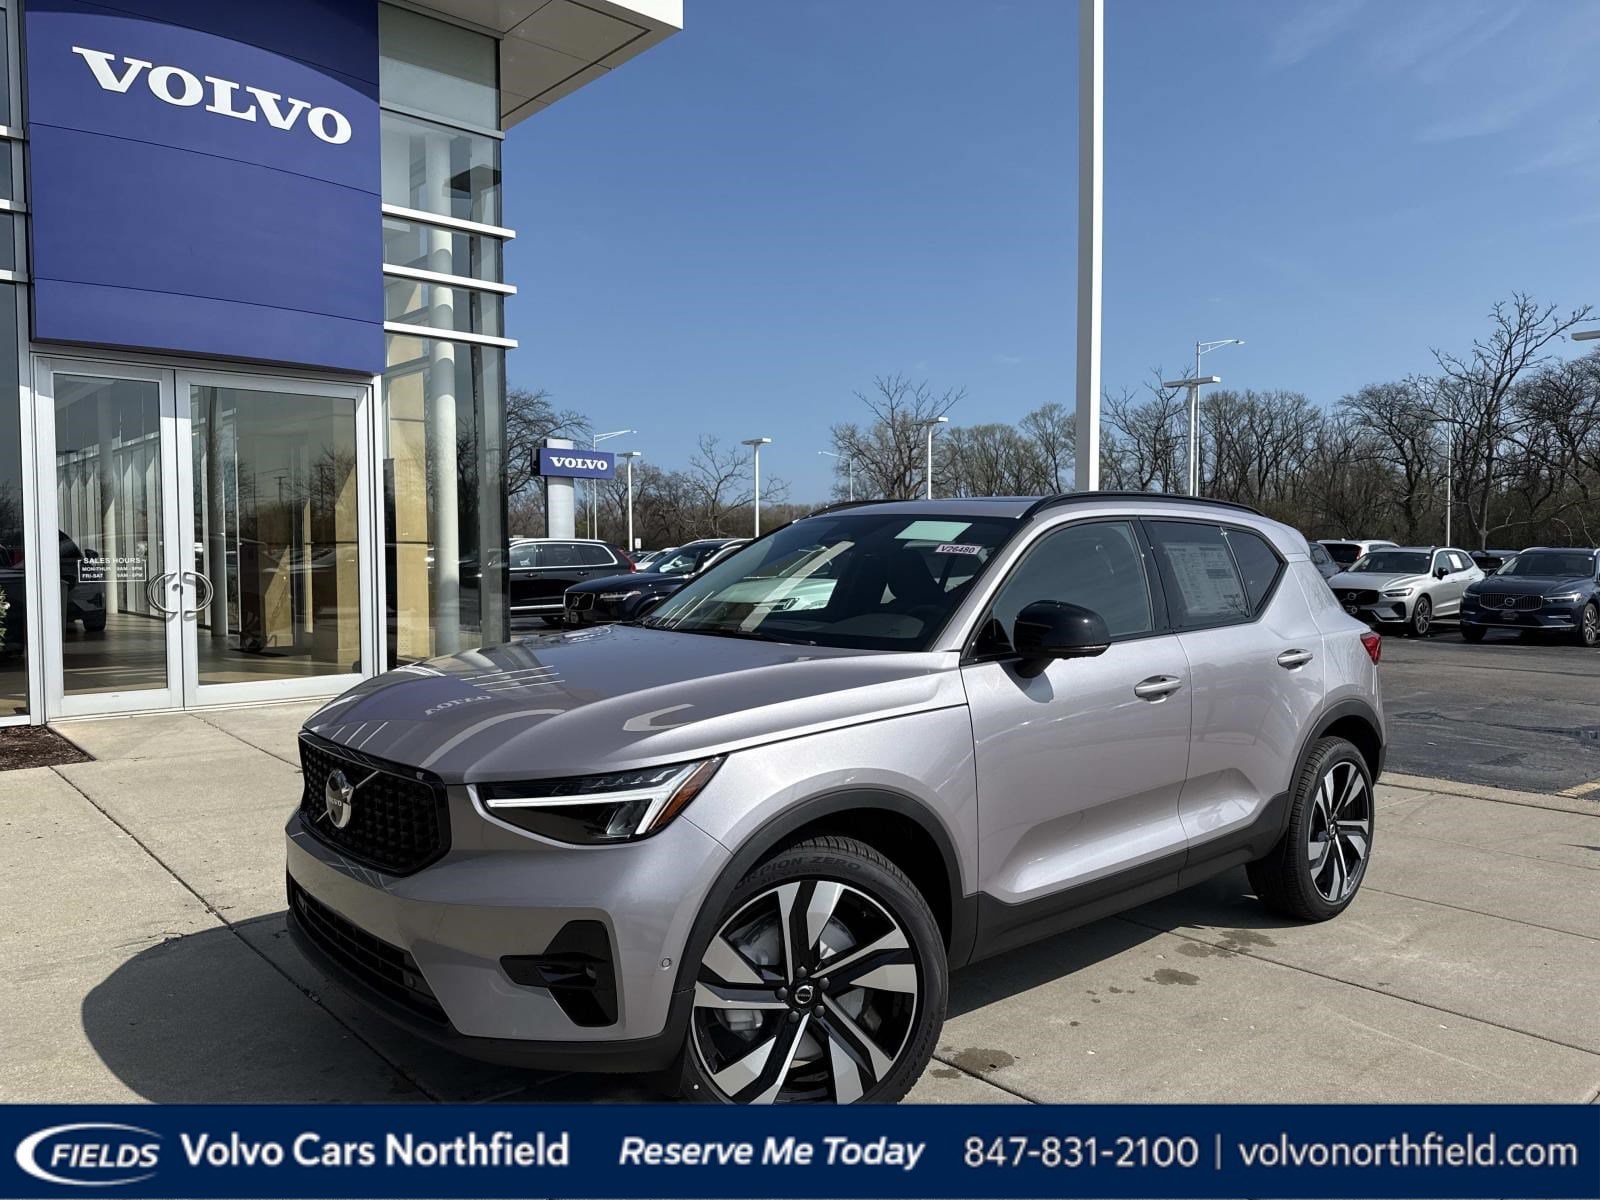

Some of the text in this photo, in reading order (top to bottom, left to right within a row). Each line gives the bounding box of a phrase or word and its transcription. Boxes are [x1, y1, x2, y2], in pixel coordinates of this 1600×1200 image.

[72, 47, 352, 145] VOLVO
[549, 456, 608, 471] VOLVO
[809, 856, 861, 870] ZERO
